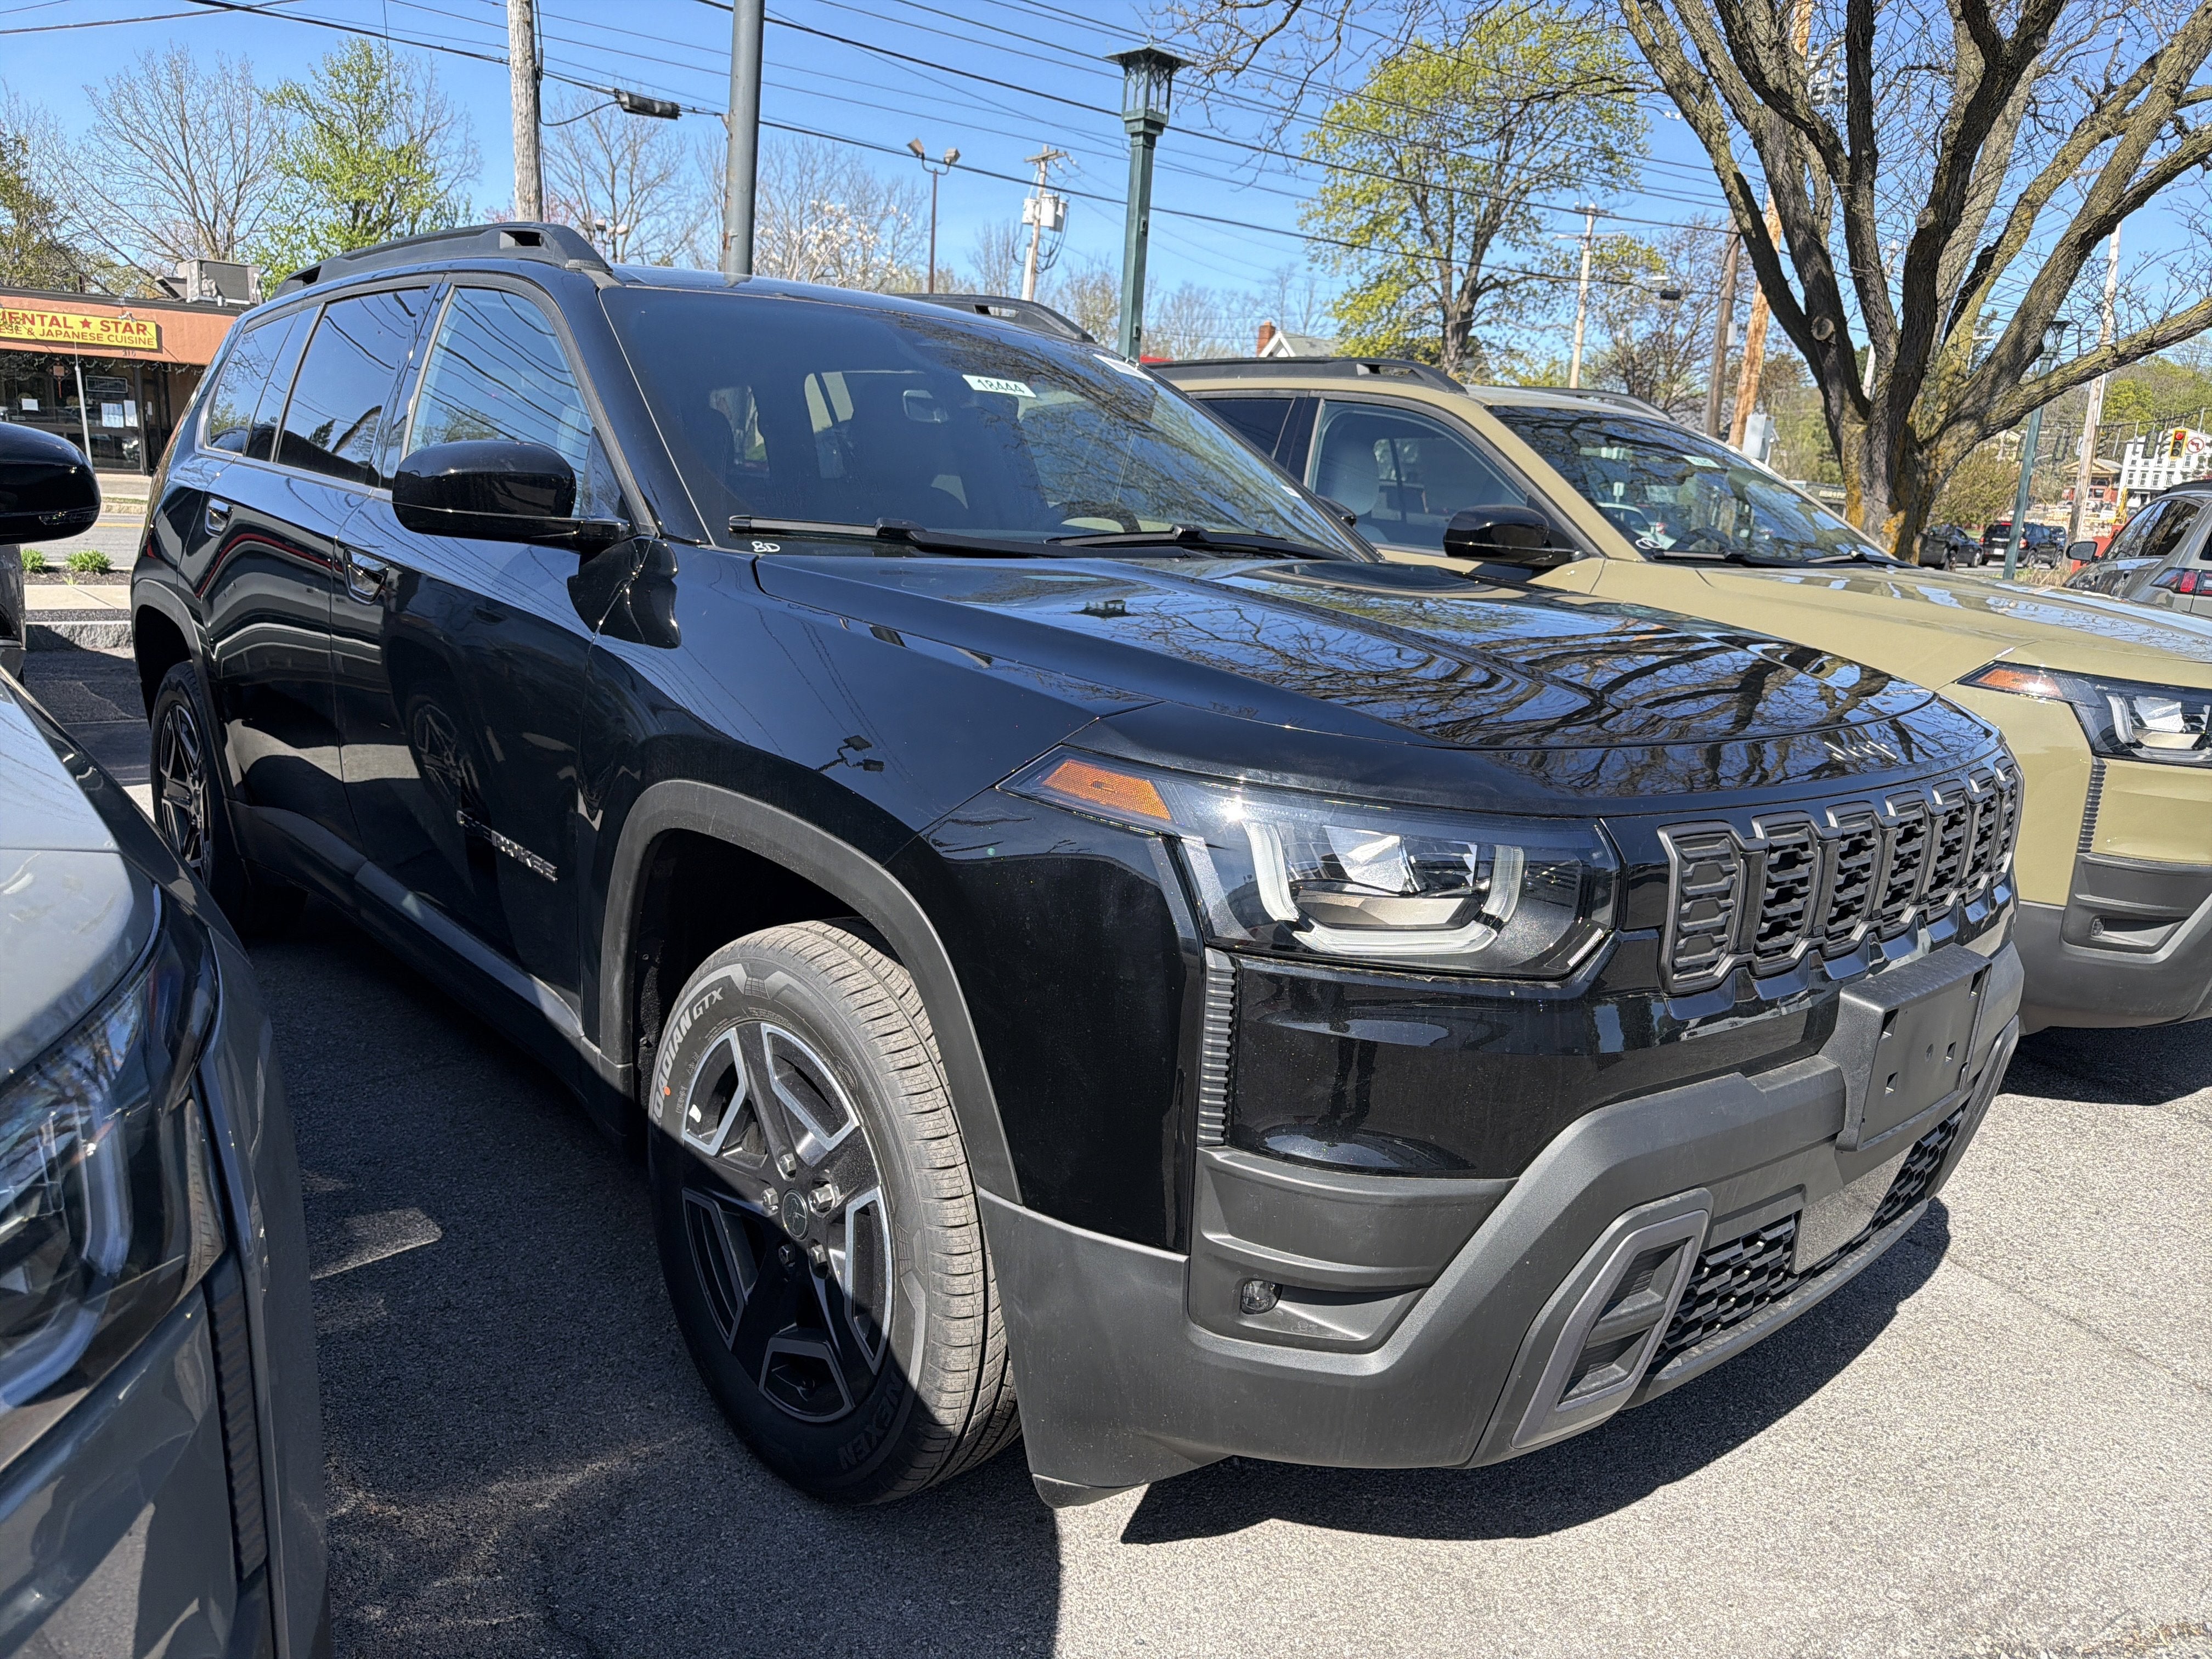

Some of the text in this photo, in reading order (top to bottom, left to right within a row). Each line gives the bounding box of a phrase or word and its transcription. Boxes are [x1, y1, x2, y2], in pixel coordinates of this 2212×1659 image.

[0, 310, 147, 336] IENTAL STAR
[39, 328, 104, 341] JAPANESE
[107, 334, 154, 346] CUISINE
[977, 379, 1025, 393] 18444
[693, 987, 724, 1020] GTX
